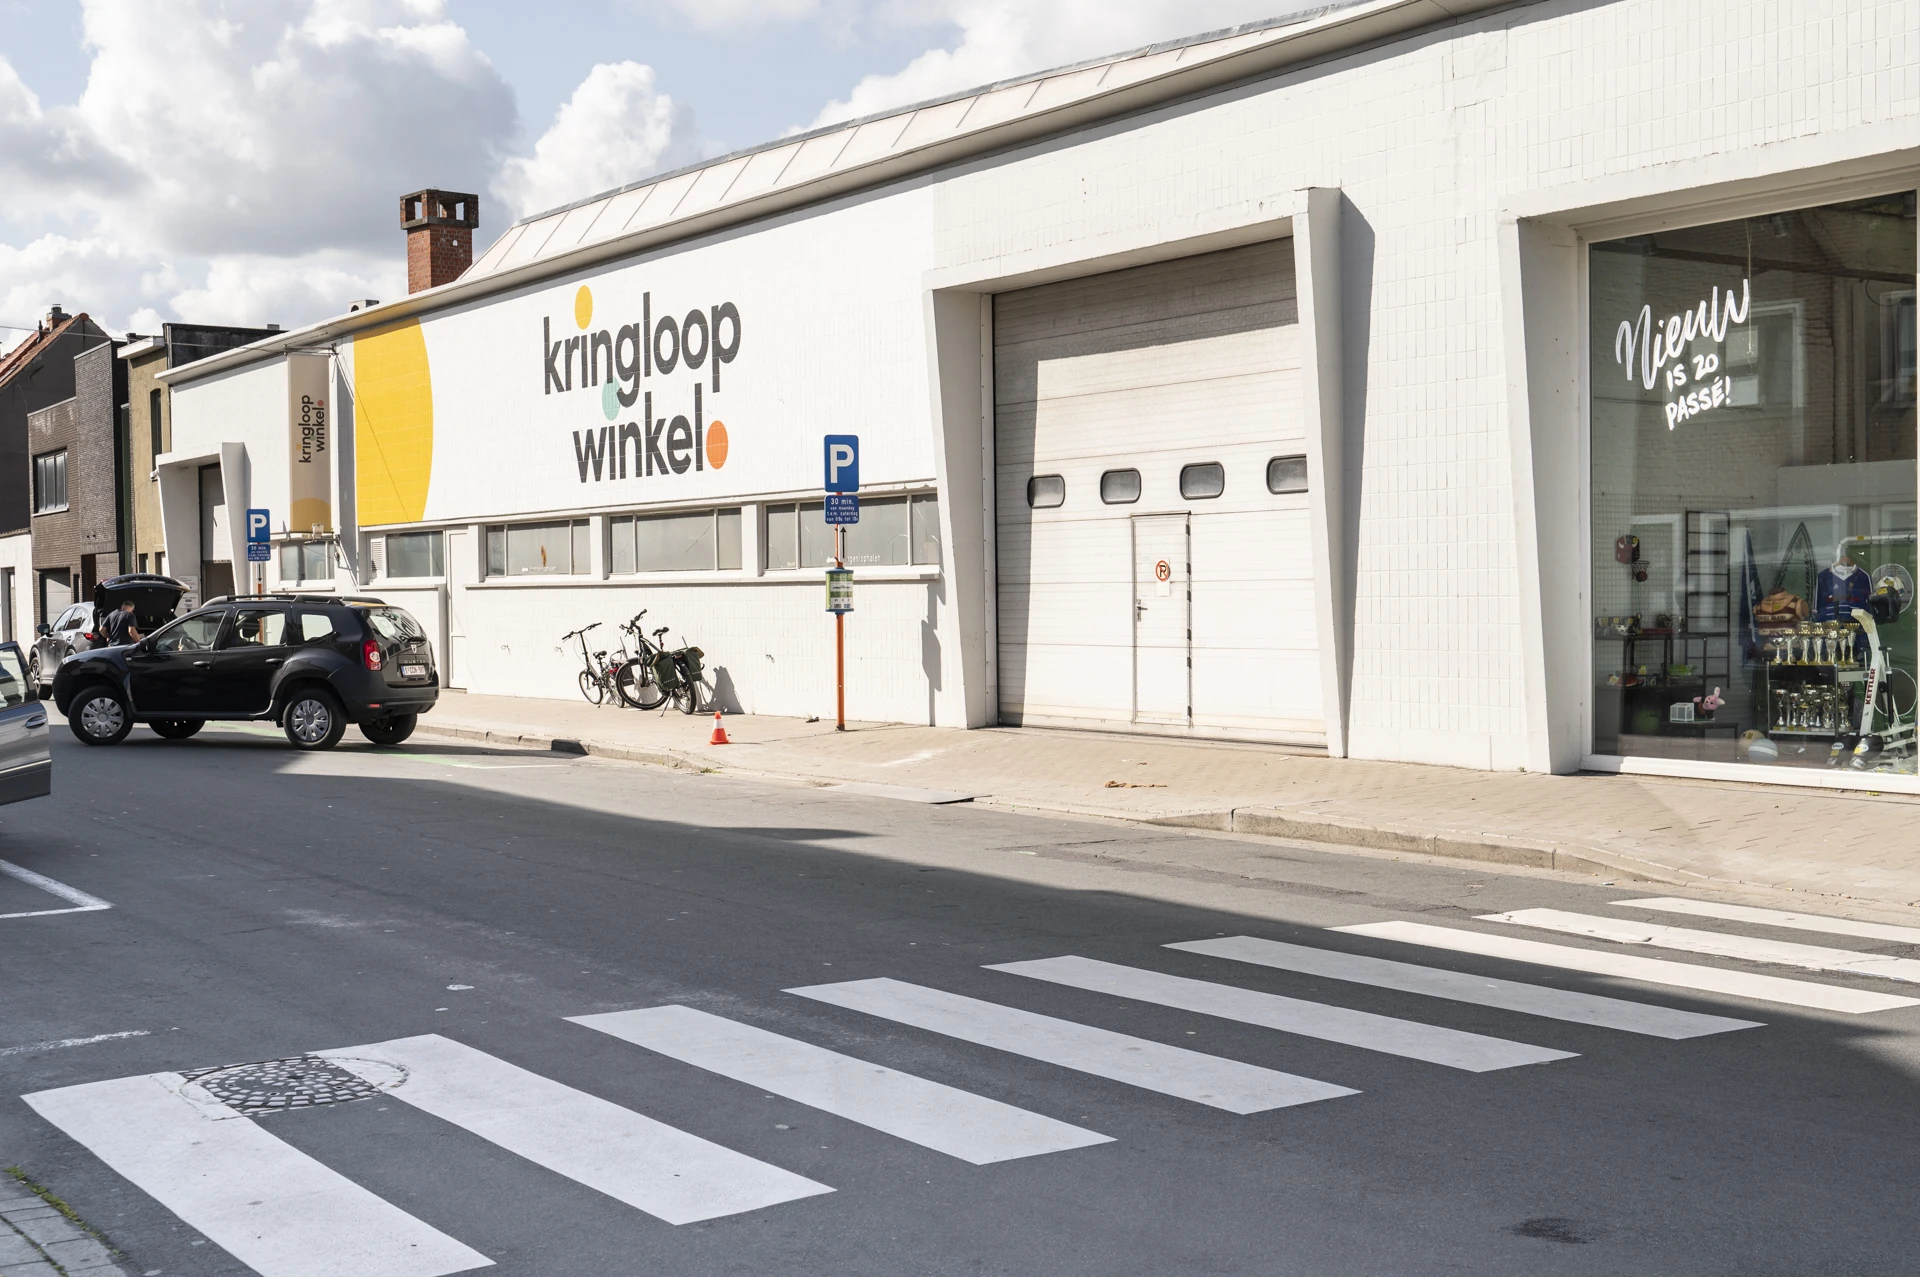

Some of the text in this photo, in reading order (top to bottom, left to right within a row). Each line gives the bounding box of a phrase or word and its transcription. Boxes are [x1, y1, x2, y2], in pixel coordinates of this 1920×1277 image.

[543, 288, 742, 408] kringloop
[1615, 278, 1750, 390] Nieuw
[1666, 363, 1687, 392] IS
[1665, 375, 1732, 431] PASSÉ!
[297, 395, 314, 463] kringloop
[311, 407, 325, 452] winkel
[572, 378, 704, 483] winkel
[829, 444, 855, 484] P
[250, 514, 267, 538] P
[1865, 668, 1877, 705] KETTLER
